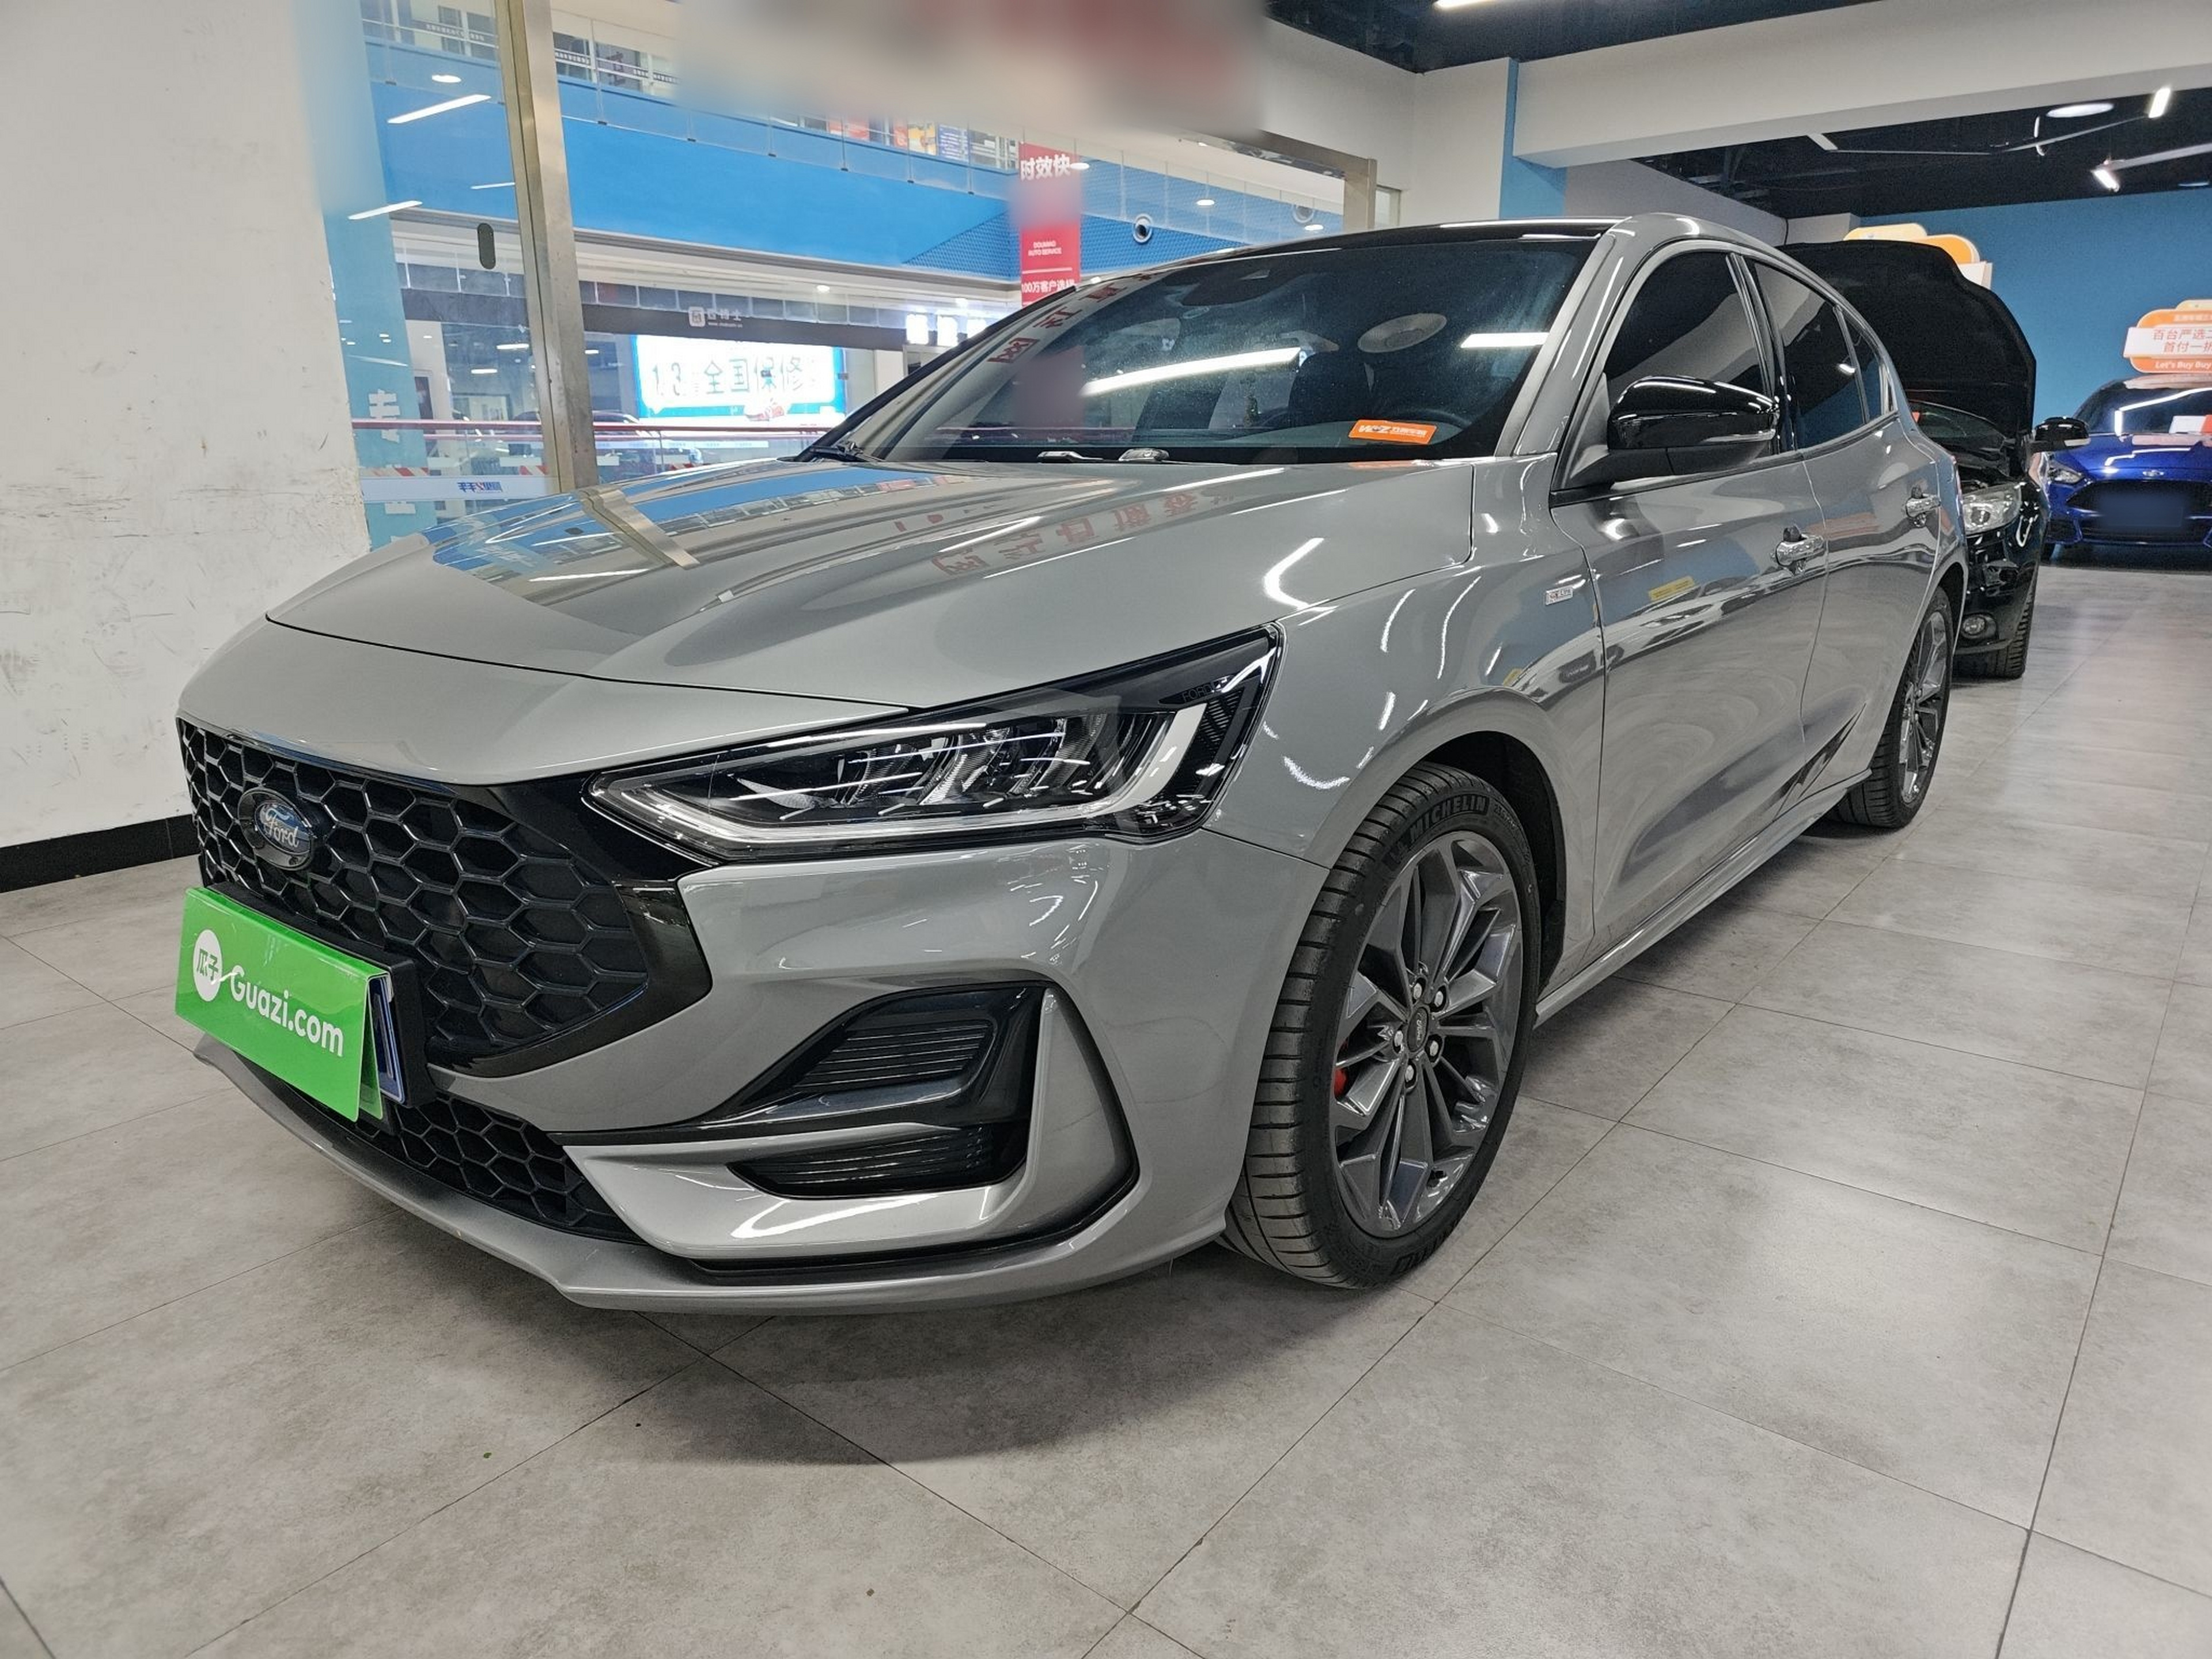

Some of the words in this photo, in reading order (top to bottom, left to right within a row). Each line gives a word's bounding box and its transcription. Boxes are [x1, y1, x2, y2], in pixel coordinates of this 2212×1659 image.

[2177, 361, 2193, 370] Buy
[1182, 684, 1212, 703] FORD
[265, 808, 300, 848] Ford
[1409, 794, 1487, 843] MICHELIN
[196, 948, 219, 980] 瓜子
[230, 964, 344, 1058] Guazi.com
